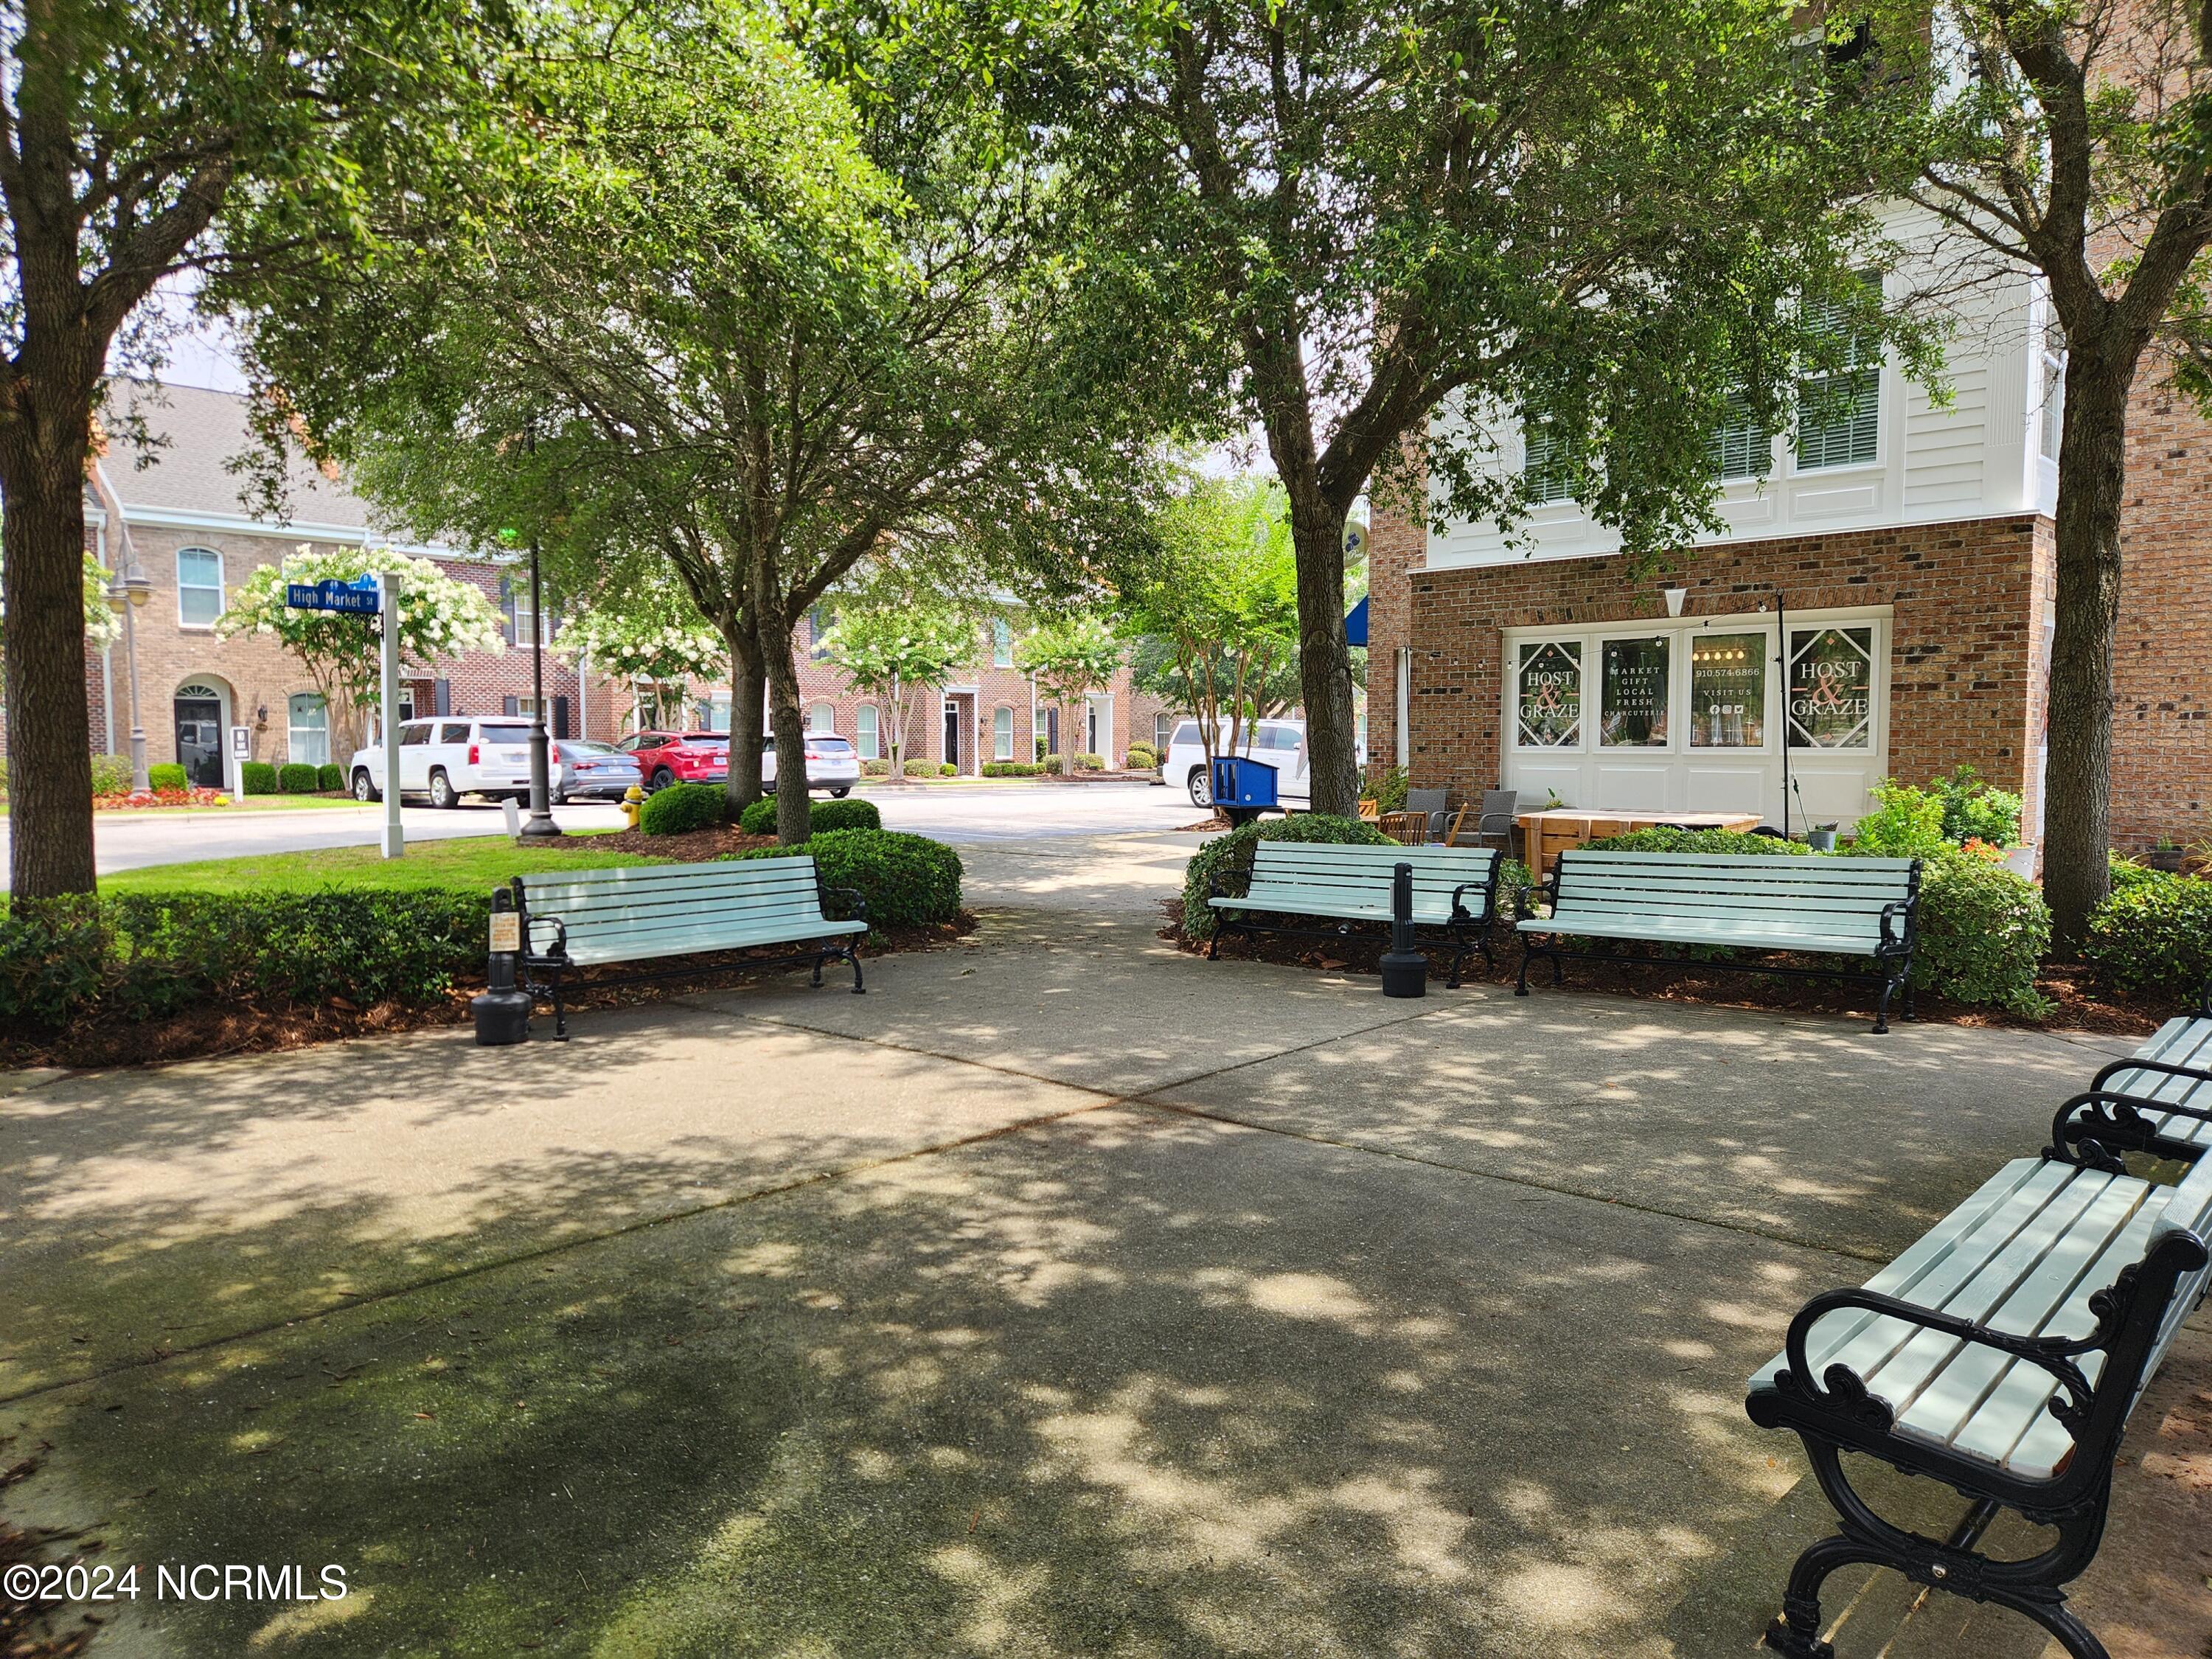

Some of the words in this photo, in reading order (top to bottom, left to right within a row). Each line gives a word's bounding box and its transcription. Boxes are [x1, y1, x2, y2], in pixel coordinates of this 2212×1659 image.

[293, 588, 318, 607] High
[325, 591, 361, 607] Market
[366, 596, 373, 605] St
[1610, 667, 1660, 675] MARKET
[1695, 667, 1760, 678] 910.574.6866
[1800, 661, 1861, 678] HOST
[1527, 671, 1573, 686] HOST
[1621, 678, 1649, 686] GIFT
[1536, 681, 1562, 709] &
[1615, 688, 1654, 696] LOCAL
[1812, 673, 1846, 705] &
[1615, 698, 1652, 706] FRESH
[1791, 698, 1868, 716] GRAZE
[1520, 703, 1579, 719] GRAZE
[1604, 709, 1665, 717] CHARCUTERIE
